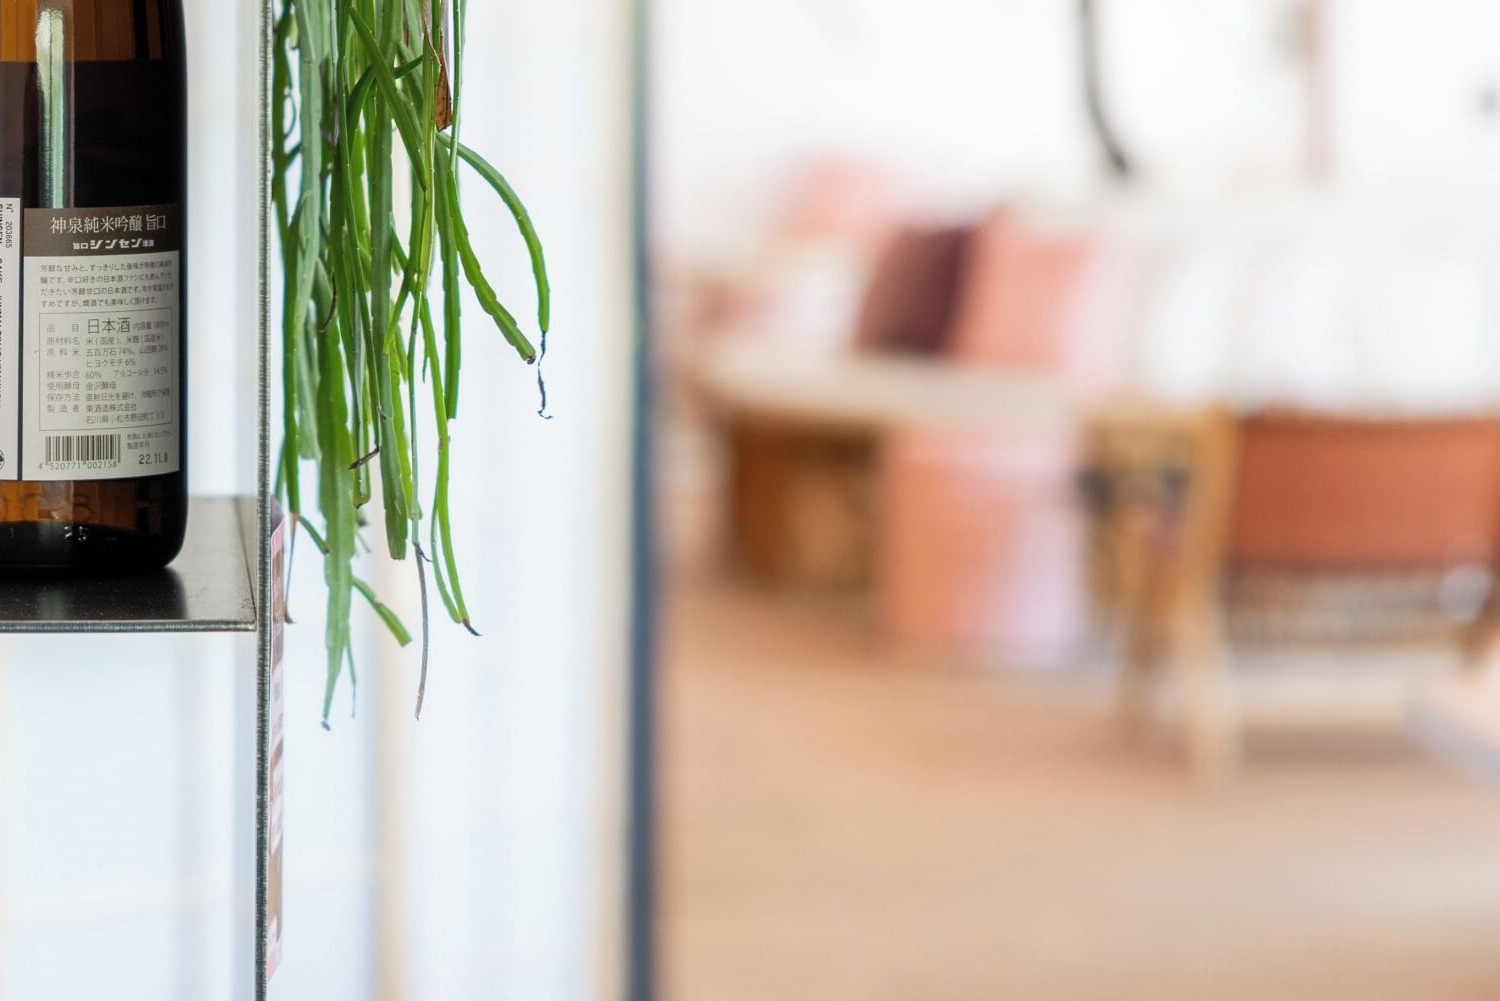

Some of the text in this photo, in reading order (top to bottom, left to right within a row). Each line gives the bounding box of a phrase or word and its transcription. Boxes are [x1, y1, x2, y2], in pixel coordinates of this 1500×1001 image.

[5, 221, 13, 249] 203665
[88, 317, 131, 334] 日本酒
[47, 336, 80, 346] 原材料名
[47, 370, 80, 380] 精米歩合
[85, 371, 101, 380] 60%
[50, 462, 81, 470] 520771
[87, 460, 118, 469] 002158
